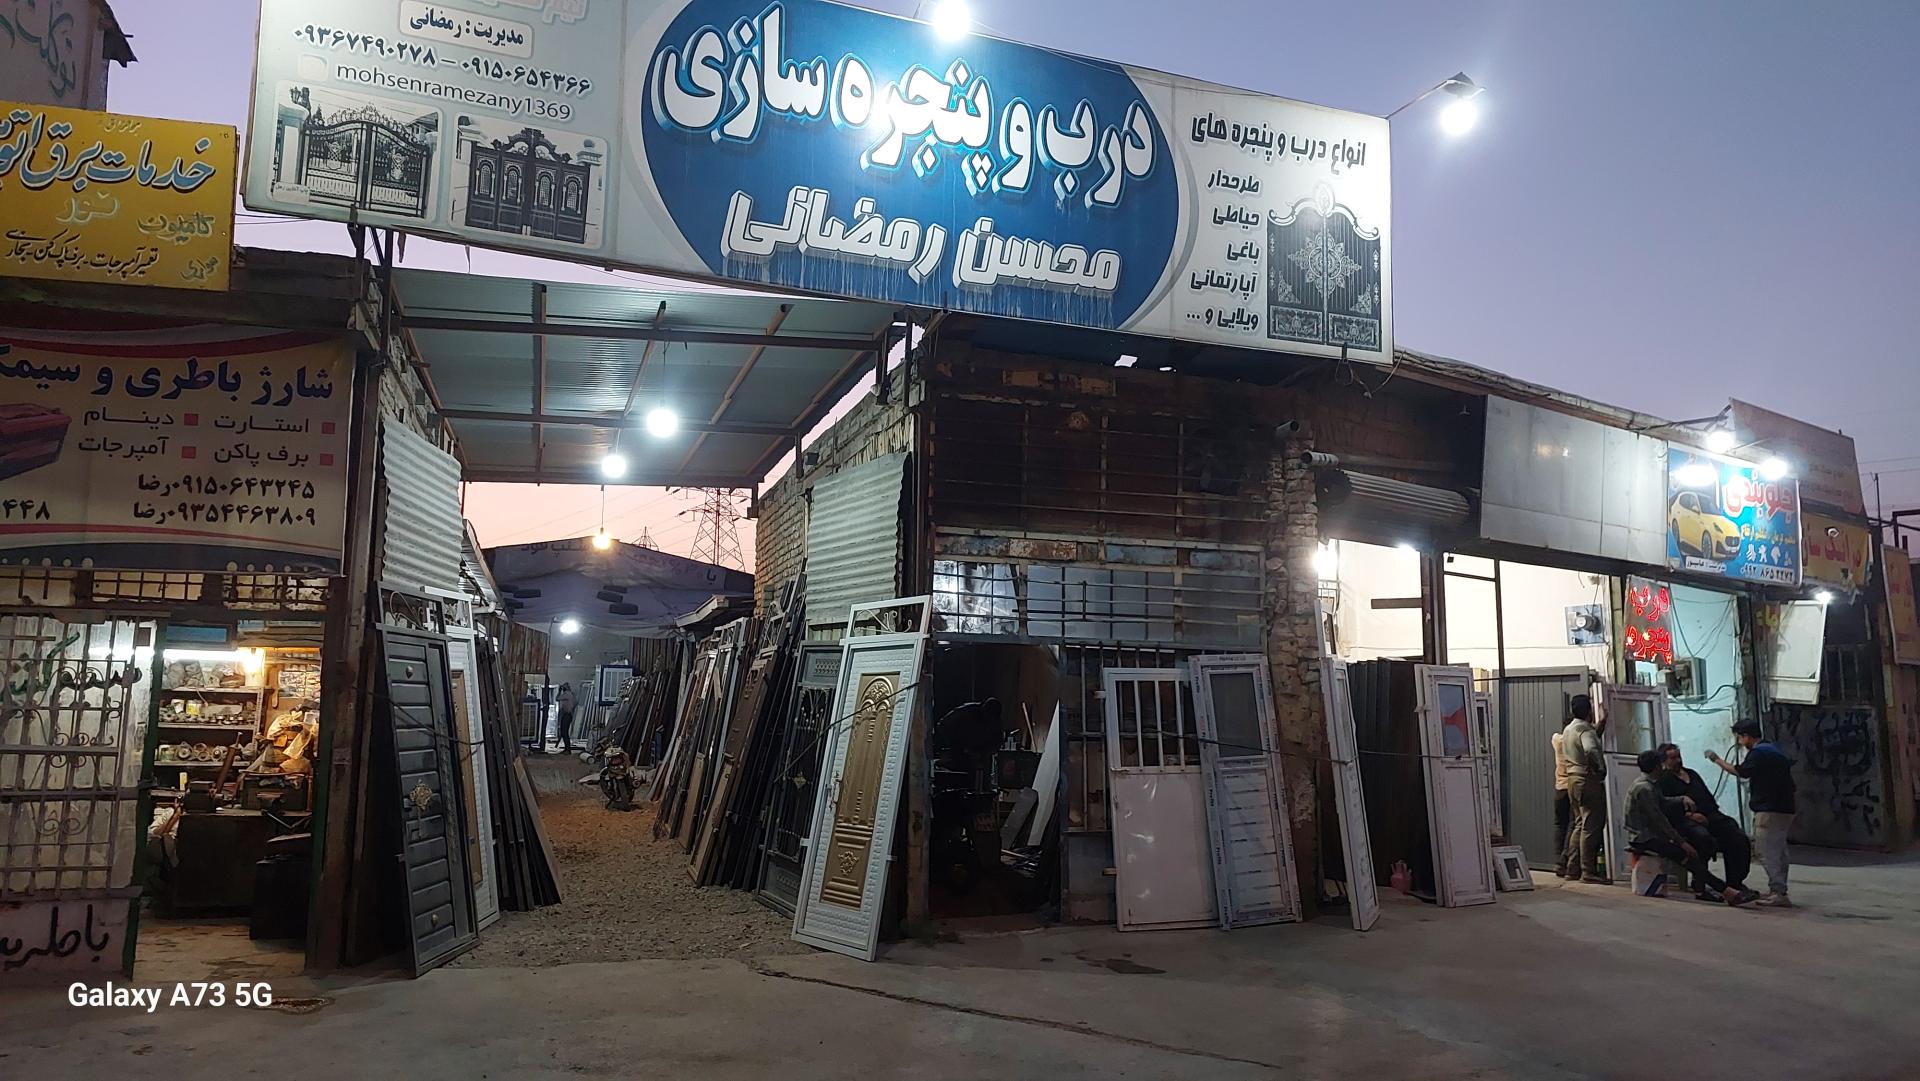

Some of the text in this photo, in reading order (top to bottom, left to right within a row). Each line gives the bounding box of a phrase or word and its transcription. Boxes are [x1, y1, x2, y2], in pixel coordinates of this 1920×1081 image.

[409, 7, 462, 38] رمضانی
[336, 64, 572, 120] mohsenramezany1369
[650, 1, 1157, 209] درب و پنجره سازی
[19, 121, 104, 193] برق
[1191, 112, 1366, 175] انواع درب و پنجره های
[85, 137, 216, 194] خدمات
[1207, 169, 1260, 194] طرحدار
[1212, 205, 1260, 230] حیاطی
[722, 186, 1124, 292] محسن رمضانی
[1226, 241, 1260, 265] باغی
[1190, 270, 1257, 300] آپارتمانی
[1205, 308, 1214, 324] و
[1217, 307, 1259, 330] ویلایی
[91, 365, 115, 396] و
[124, 357, 242, 401] باطری
[250, 366, 334, 408] شارژ
[84, 406, 175, 431] دینام
[213, 416, 310, 435] استارت
[78, 436, 170, 462] آمپرجات
[213, 443, 310, 468] برف پاکن
[1630, 585, 1670, 621] درب
[1625, 625, 1672, 665] پنجره
